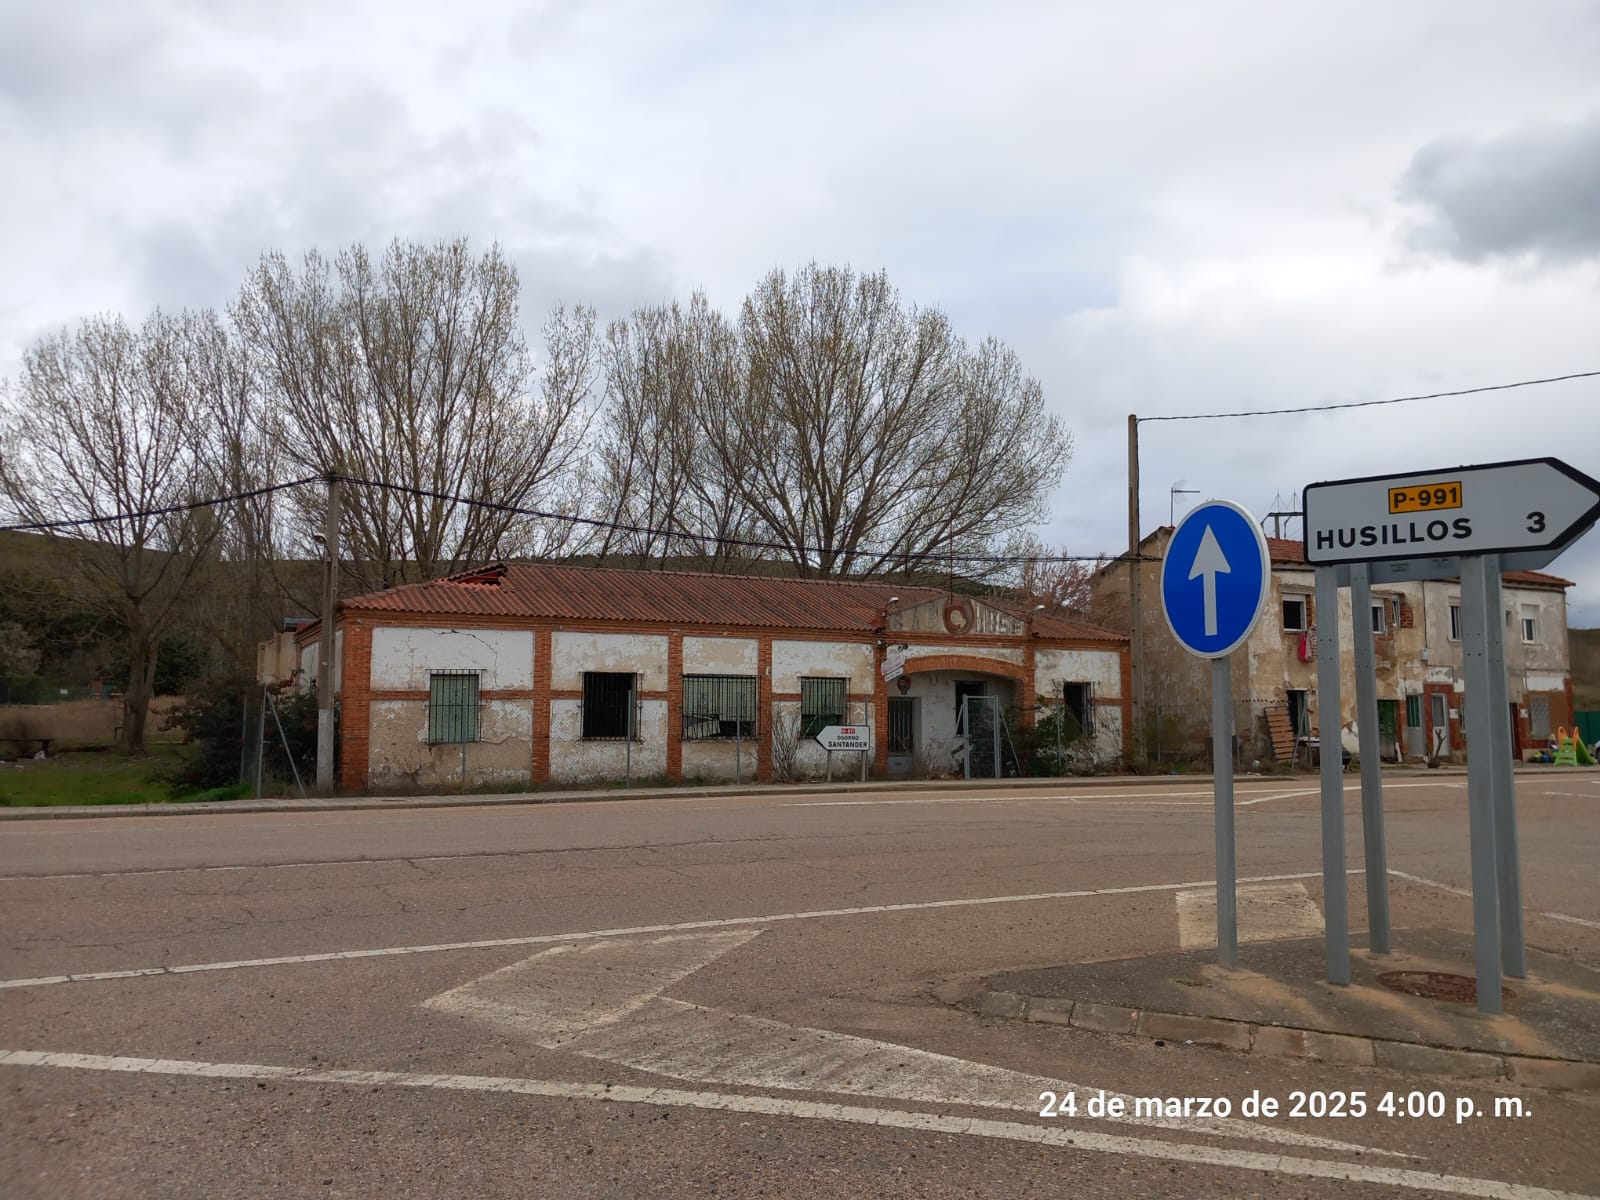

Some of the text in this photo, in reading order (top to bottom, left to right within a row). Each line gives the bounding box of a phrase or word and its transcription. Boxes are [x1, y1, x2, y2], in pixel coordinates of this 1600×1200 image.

[1393, 487, 1458, 509] P-991
[1316, 511, 1546, 550] HUSILLOS 3
